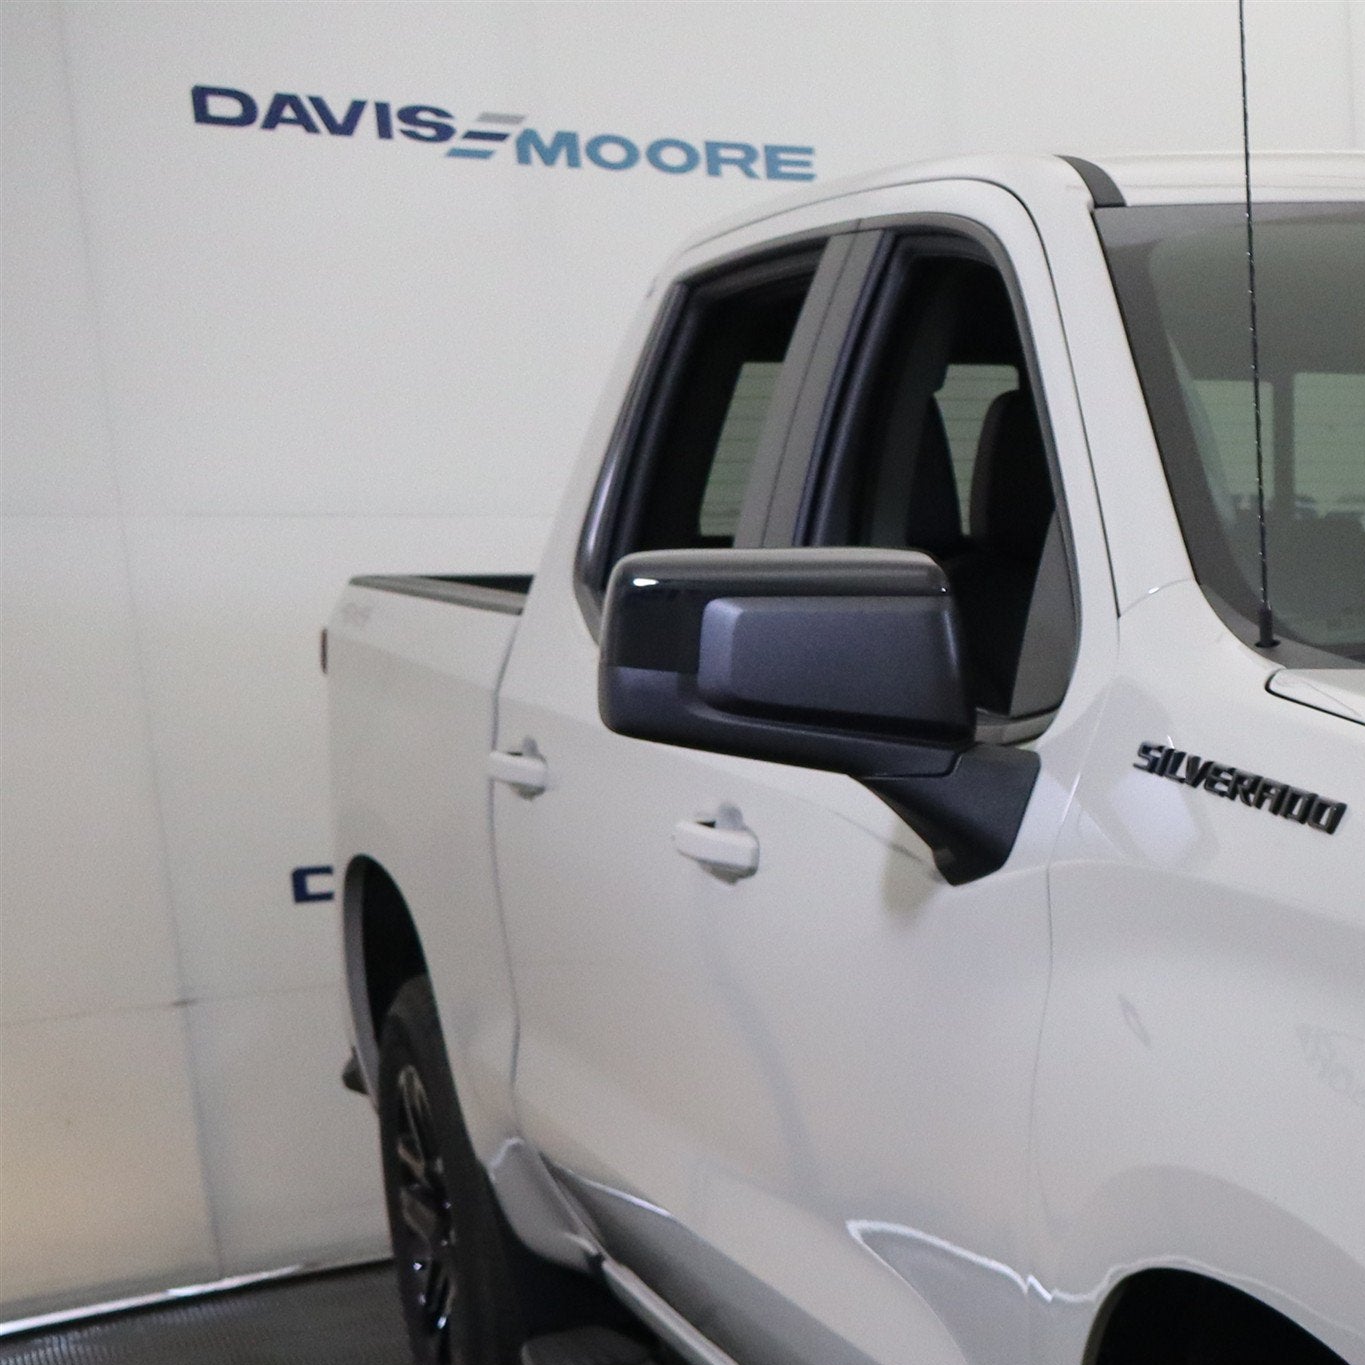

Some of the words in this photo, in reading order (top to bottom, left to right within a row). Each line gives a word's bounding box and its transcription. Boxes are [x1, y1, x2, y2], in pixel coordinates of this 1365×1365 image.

[190, 85, 458, 143] DAVIS
[514, 127, 817, 182] MOORE
[1132, 739, 1348, 835] SILVERADO
